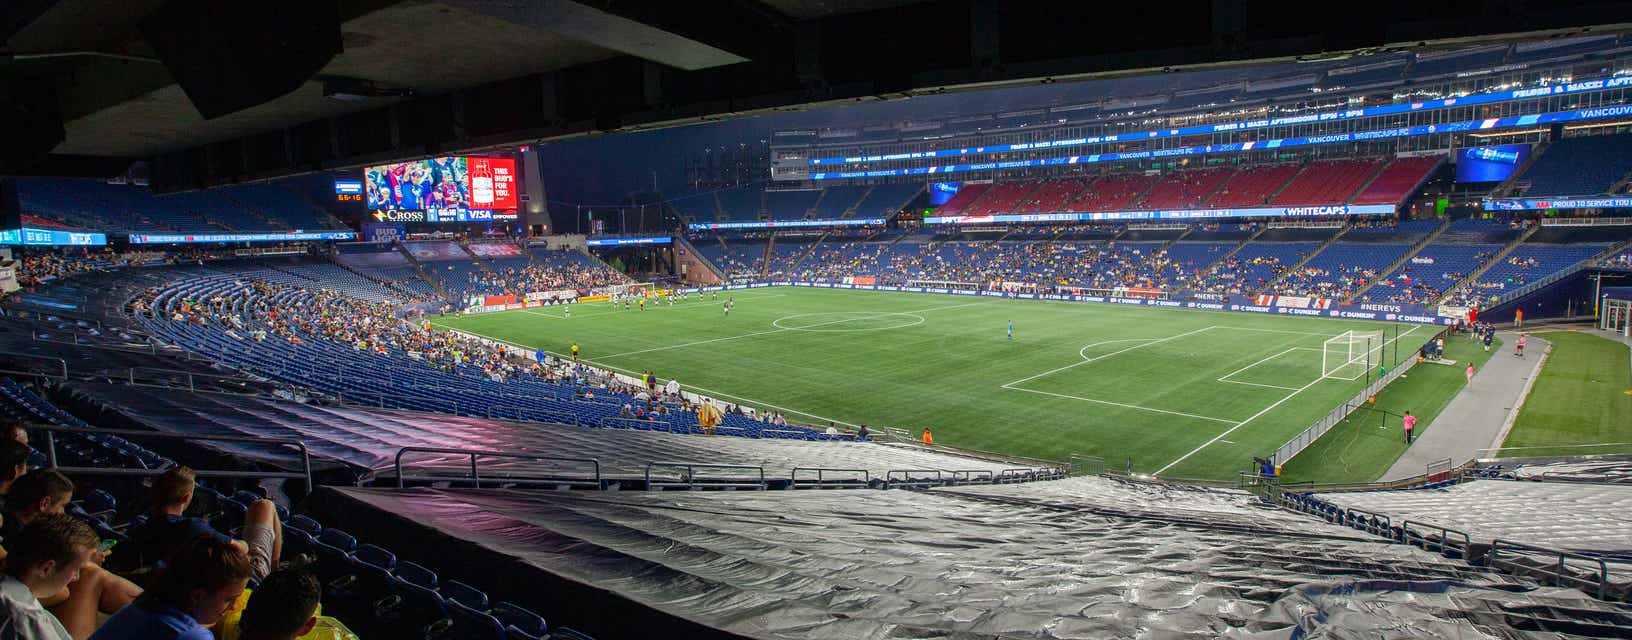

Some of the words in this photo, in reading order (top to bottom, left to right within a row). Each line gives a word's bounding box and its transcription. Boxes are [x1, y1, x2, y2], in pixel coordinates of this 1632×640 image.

[1308, 134, 1350, 144] VANCOUVER
[1577, 200, 1586, 208] TO
[1586, 199, 1613, 208] SERVICE
[1615, 199, 1629, 207] YOU
[387, 209, 424, 220] CROSS
[468, 210, 492, 219] VISA
[1287, 205, 1345, 216] WHITECAPS
[1361, 303, 1401, 313] #NEREVS
